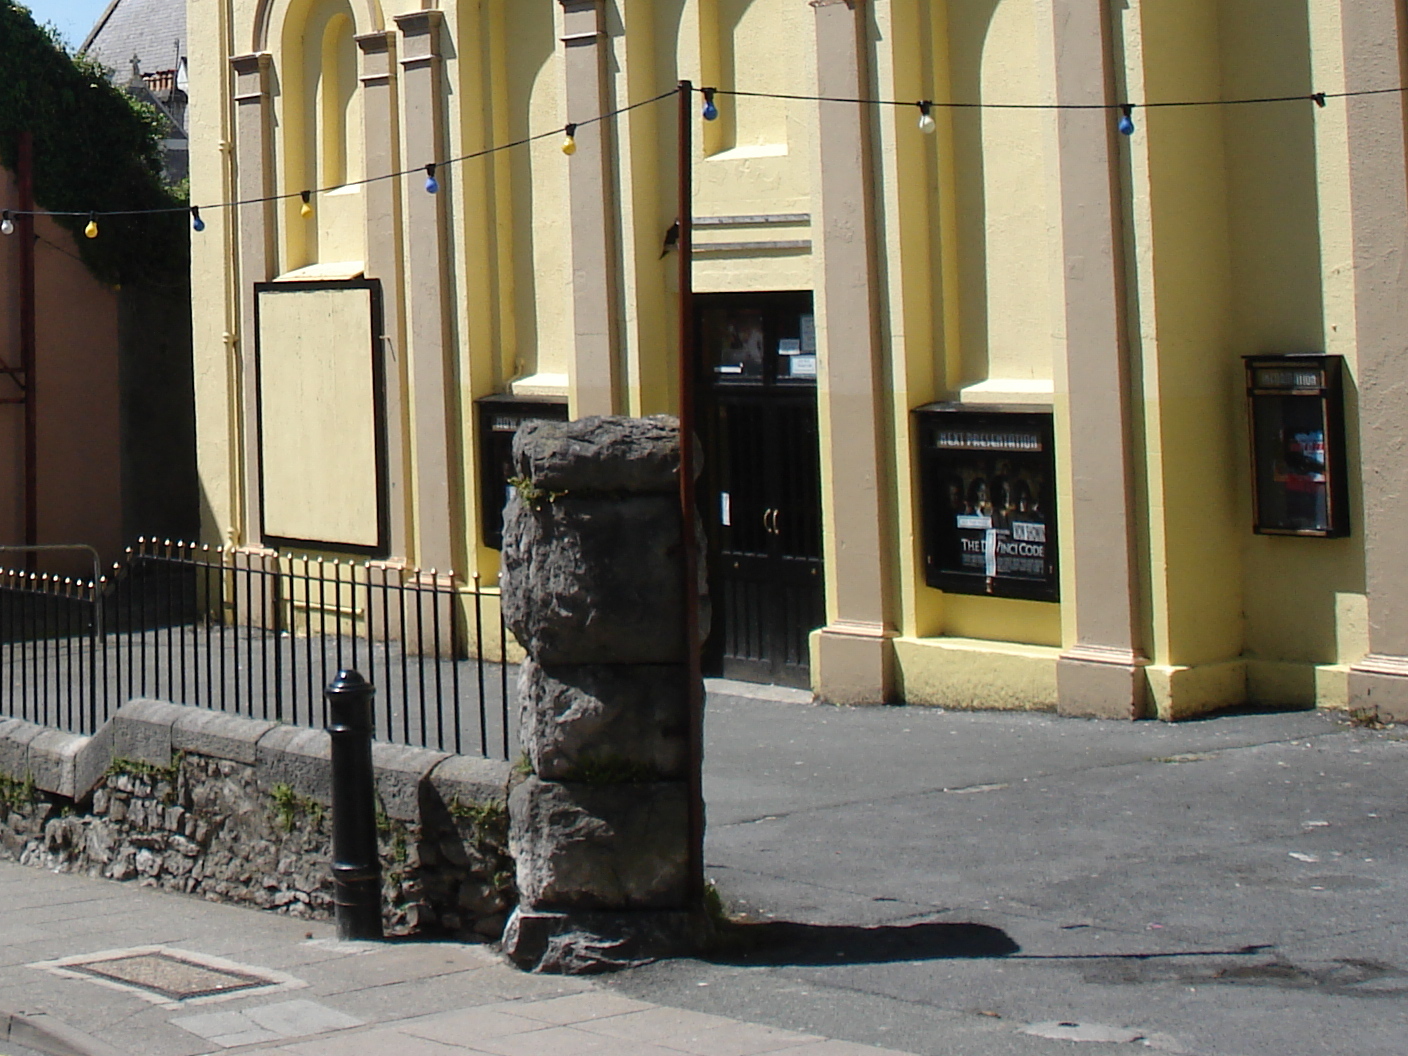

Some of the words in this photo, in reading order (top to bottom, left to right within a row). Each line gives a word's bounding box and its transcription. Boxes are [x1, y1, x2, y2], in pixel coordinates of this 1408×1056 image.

[940, 432, 965, 446] NEXT
[966, 433, 1038, 449] PRESENTATION
[961, 538, 980, 552] THE
[1019, 542, 1045, 557] CODE
